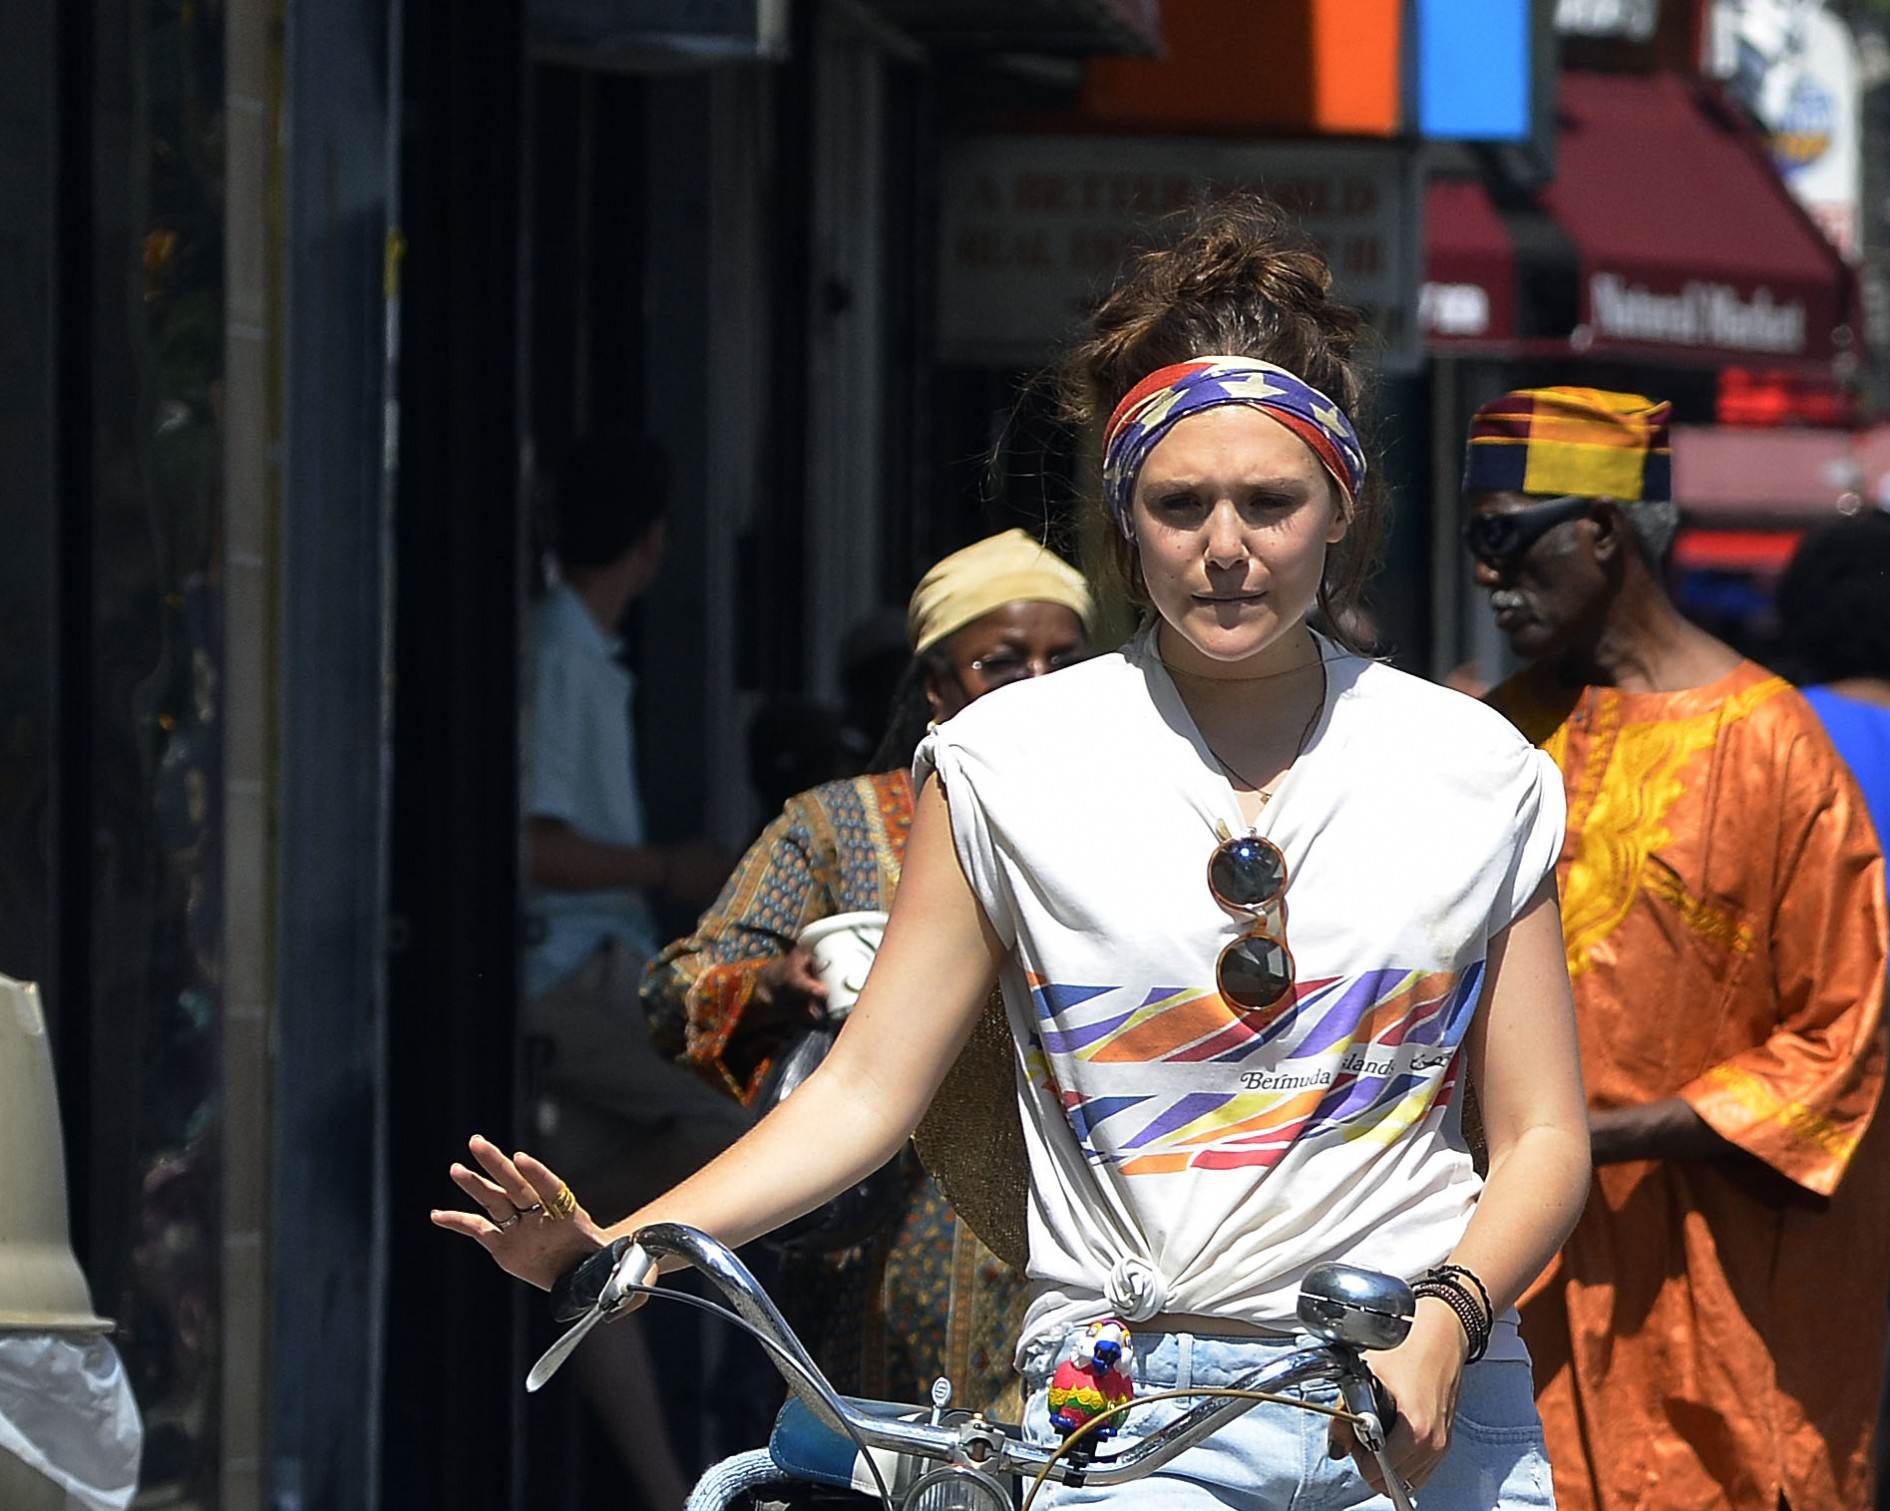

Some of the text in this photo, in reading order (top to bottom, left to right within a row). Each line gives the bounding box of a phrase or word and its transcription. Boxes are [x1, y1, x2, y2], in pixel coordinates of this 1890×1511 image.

[1590, 271, 1807, 355] Natural Market
[1239, 1067, 1331, 1090] Bermuda
